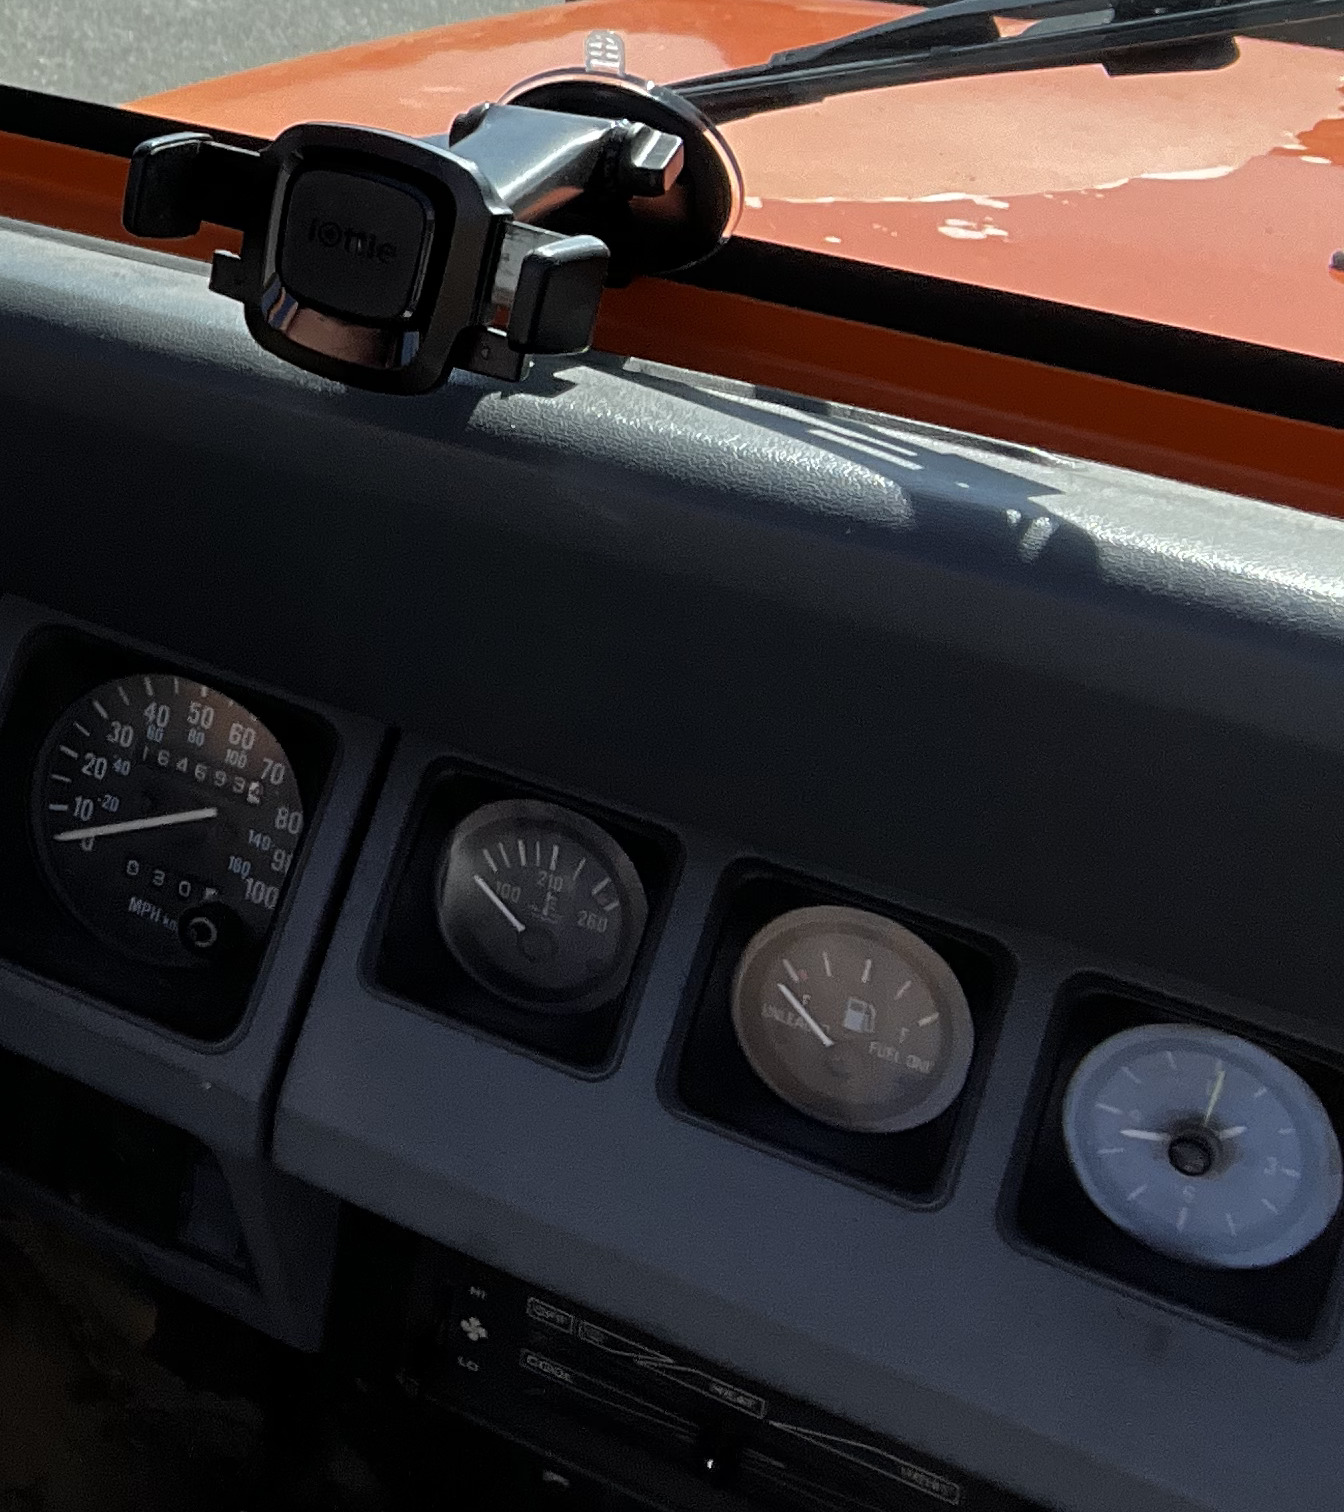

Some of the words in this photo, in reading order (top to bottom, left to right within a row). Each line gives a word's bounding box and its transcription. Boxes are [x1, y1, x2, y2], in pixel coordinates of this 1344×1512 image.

[144, 702, 170, 728] 40
[187, 701, 214, 729] 50
[107, 720, 133, 748] 30
[229, 722, 257, 751] 60
[81, 752, 108, 780] 20
[113, 758, 131, 777] 40
[261, 757, 286, 786] 70
[72, 795, 94, 822] 10
[101, 794, 121, 814] 20
[275, 807, 304, 835] 80
[245, 877, 280, 910] 100
[536, 870, 563, 893] 210
[128, 896, 161, 922] MPH
